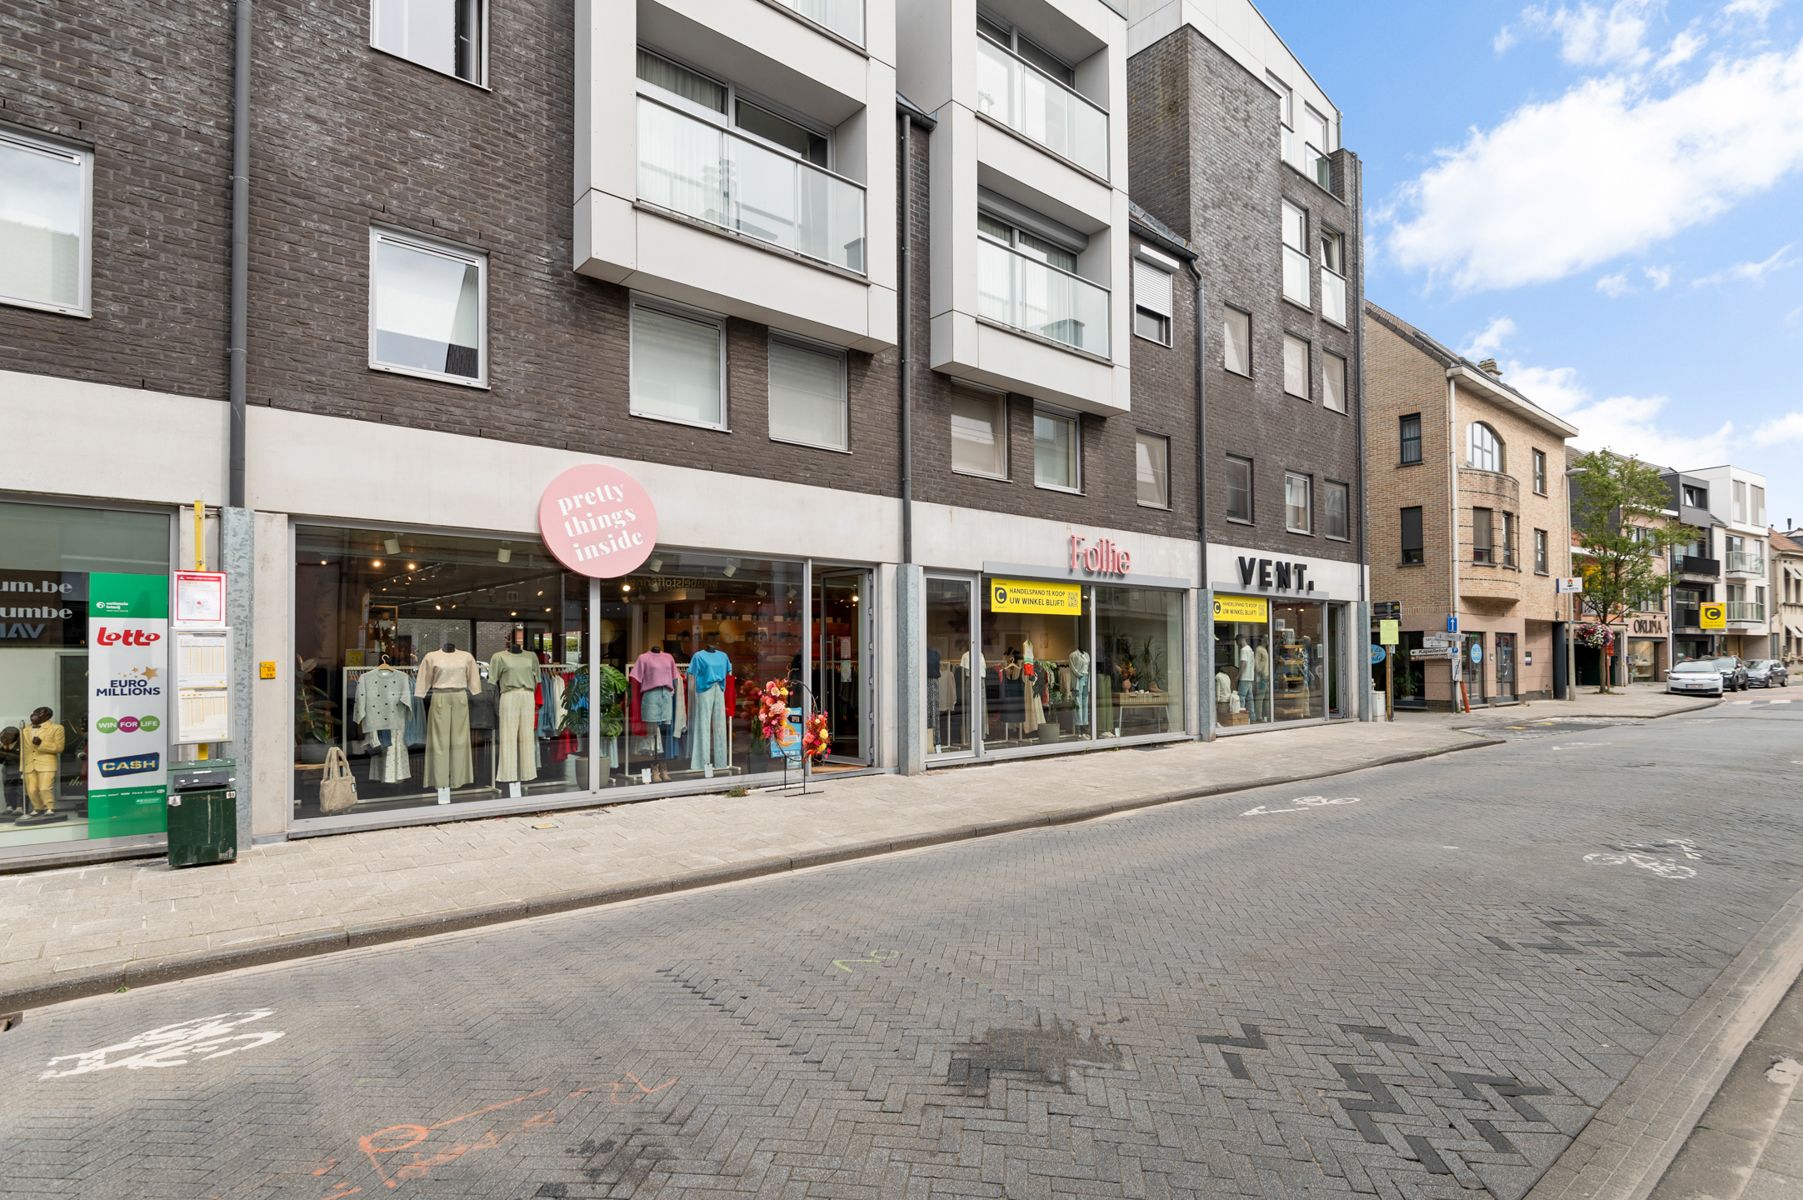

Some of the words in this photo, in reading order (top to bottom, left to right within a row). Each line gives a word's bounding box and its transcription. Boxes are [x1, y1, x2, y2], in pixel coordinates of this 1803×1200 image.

[557, 483, 624, 516] pretty
[564, 507, 637, 538] things
[573, 530, 644, 562] inside
[1071, 534, 1131, 575] Follie
[1238, 556, 1314, 591] VENT.
[1009, 588, 1046, 596] HANDELSPAND
[1009, 597, 1020, 605] UW
[1021, 598, 1045, 606] WINKEL
[97, 627, 160, 646] Lotto
[96, 687, 161, 697] MILLIONS
[110, 679, 148, 688] EURO
